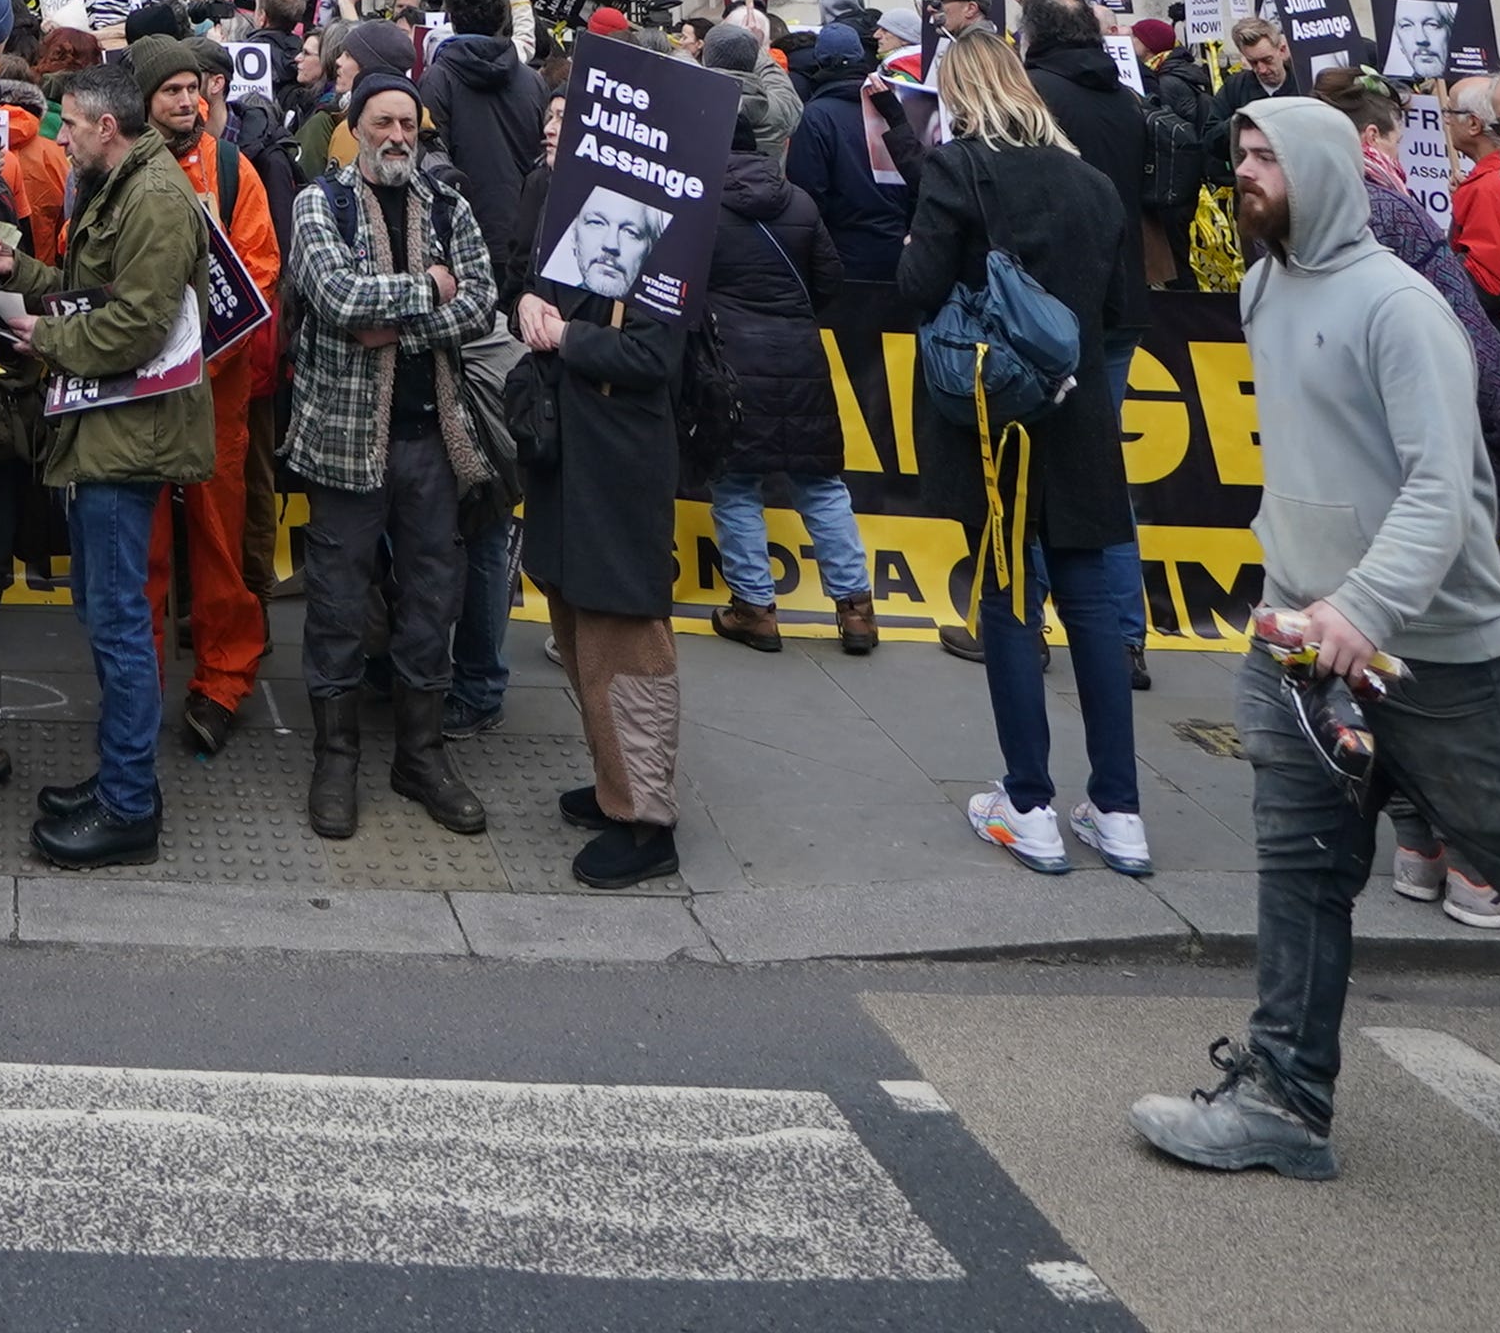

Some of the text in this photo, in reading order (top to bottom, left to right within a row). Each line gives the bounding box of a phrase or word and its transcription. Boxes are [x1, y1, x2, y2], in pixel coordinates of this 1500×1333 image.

[1192, 20, 1222, 34] NOW!
[1292, 14, 1351, 41] Assange
[586, 67, 650, 110] Free
[581, 102, 669, 153] Julian
[575, 133, 704, 199] Assange
[874, 550, 926, 602] A
